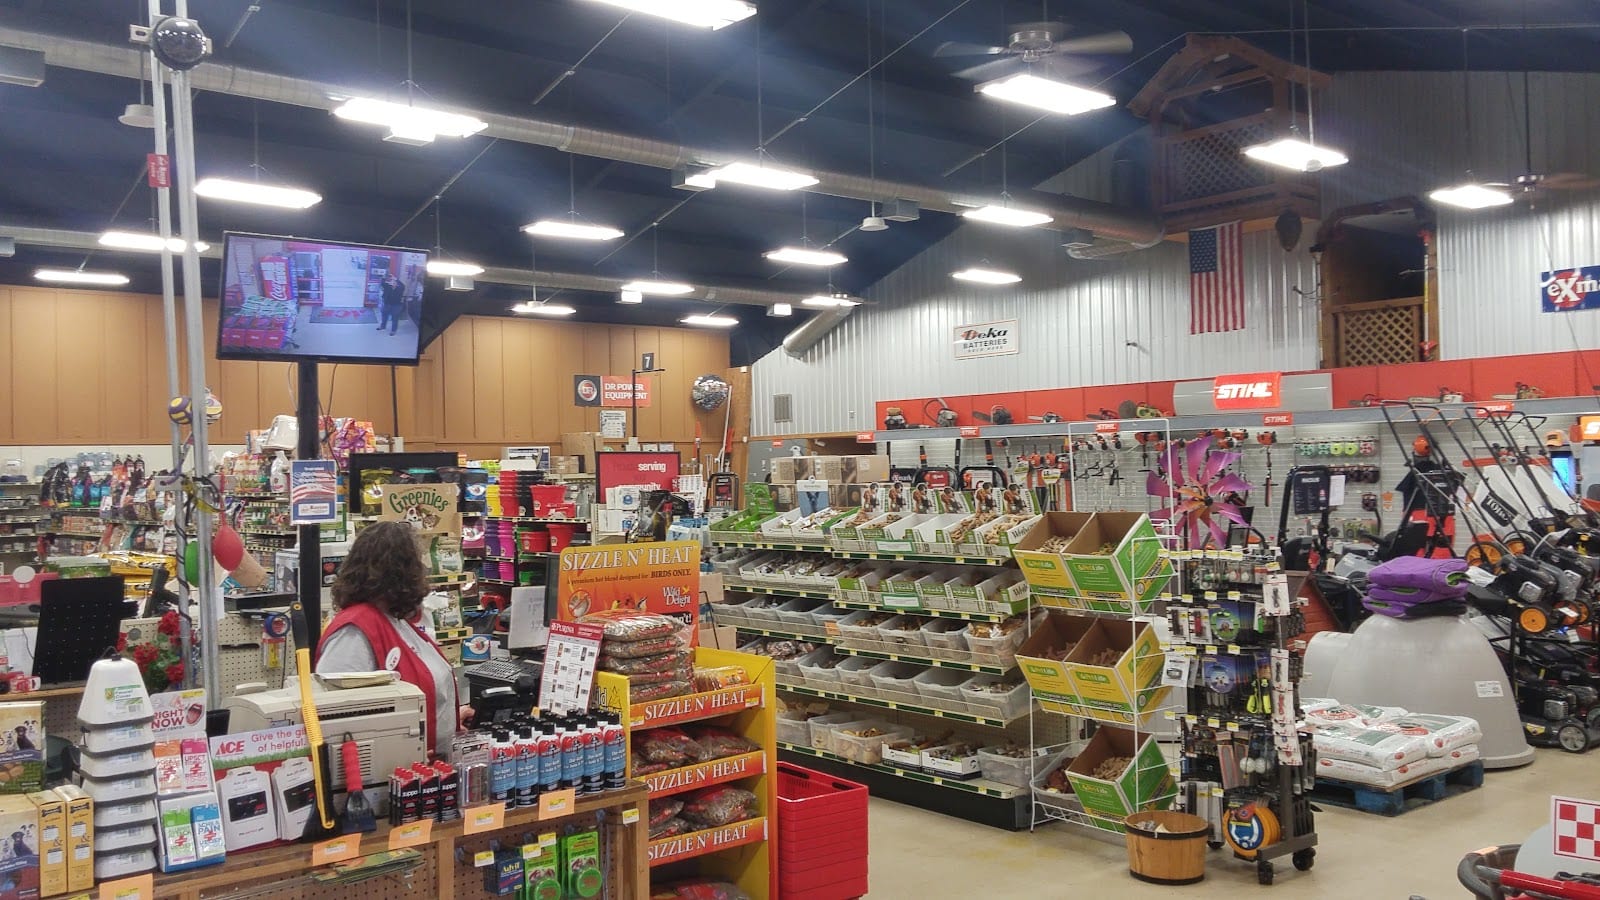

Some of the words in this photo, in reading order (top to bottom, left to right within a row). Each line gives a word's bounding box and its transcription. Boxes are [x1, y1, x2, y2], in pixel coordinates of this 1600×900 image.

[961, 328, 1008, 340] Deka
[963, 338, 1008, 349] BATTERIES
[616, 383, 644, 391] POWER
[1216, 382, 1272, 400] STIHL
[604, 391, 648, 400] EQUIPMENT
[1263, 415, 1289, 424] STIHL
[638, 462, 667, 473] serving
[389, 488, 449, 514] Greenies
[562, 550, 624, 572] SIZZLE
[647, 546, 693, 566] HEAT
[650, 569, 672, 579] BIRDS
[663, 585, 681, 597] Wild
[666, 594, 691, 608] Delight
[644, 699, 692, 720] SIZZLE
[711, 690, 746, 708] HEAT
[151, 717, 184, 729] NOW
[251, 732, 273, 743] Give
[276, 729, 292, 739] the
[215, 740, 245, 756] ACE
[257, 744, 268, 753] of
[270, 739, 307, 751] helpful.
[646, 770, 693, 793] SIZZLE
[712, 757, 748, 778] HEAT
[647, 838, 694, 861] SIZZLE
[713, 824, 749, 845] HEAT
